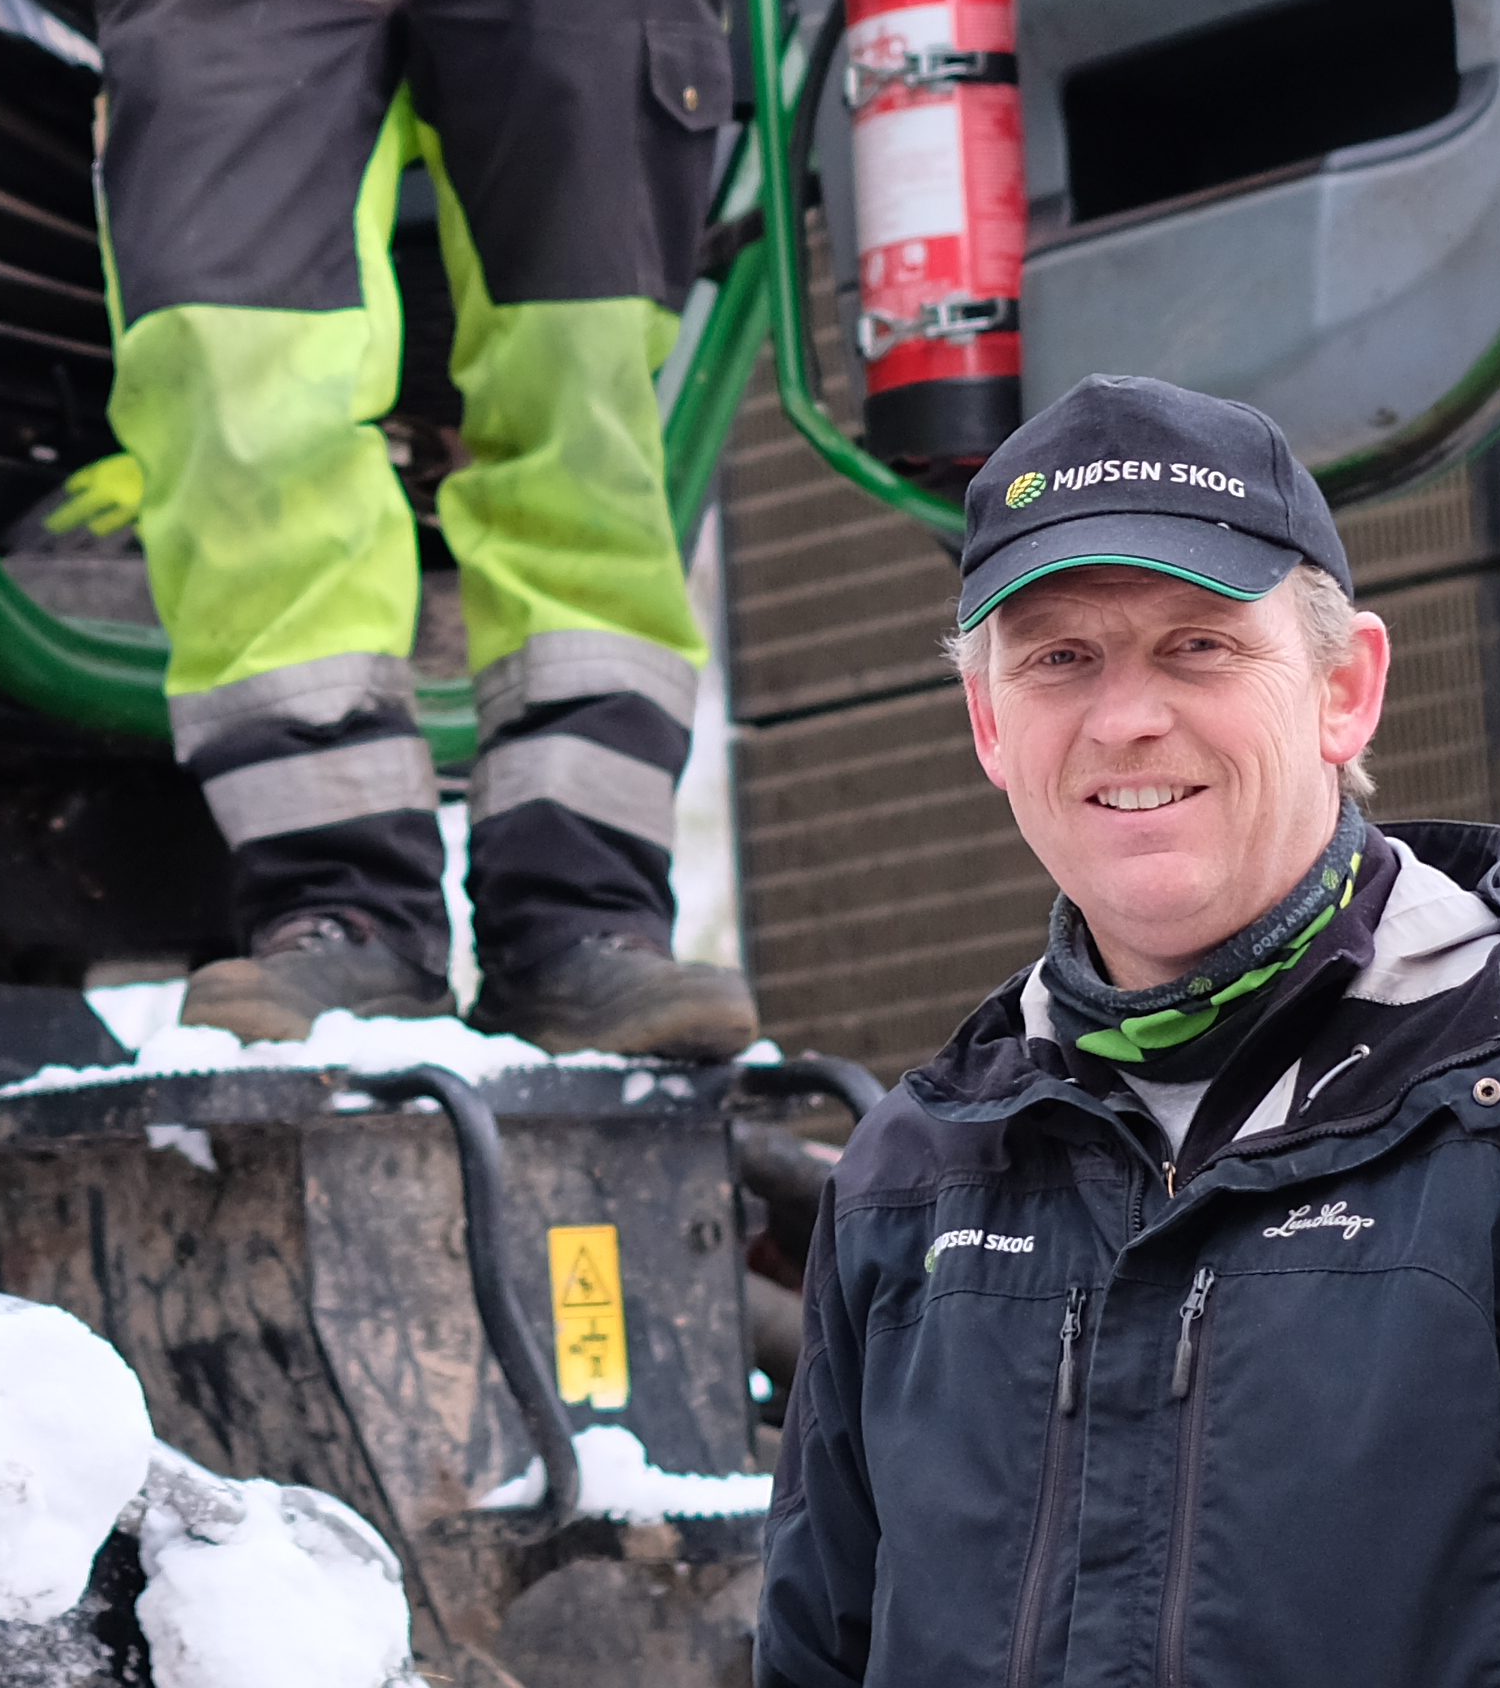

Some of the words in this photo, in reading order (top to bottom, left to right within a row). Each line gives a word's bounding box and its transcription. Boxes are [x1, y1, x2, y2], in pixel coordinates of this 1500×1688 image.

[1052, 459, 1162, 491] MJØSEN
[1170, 462, 1245, 499] SKOG
[1262, 1200, 1375, 1240] Lundhags
[984, 1234, 1035, 1253] SKOG
